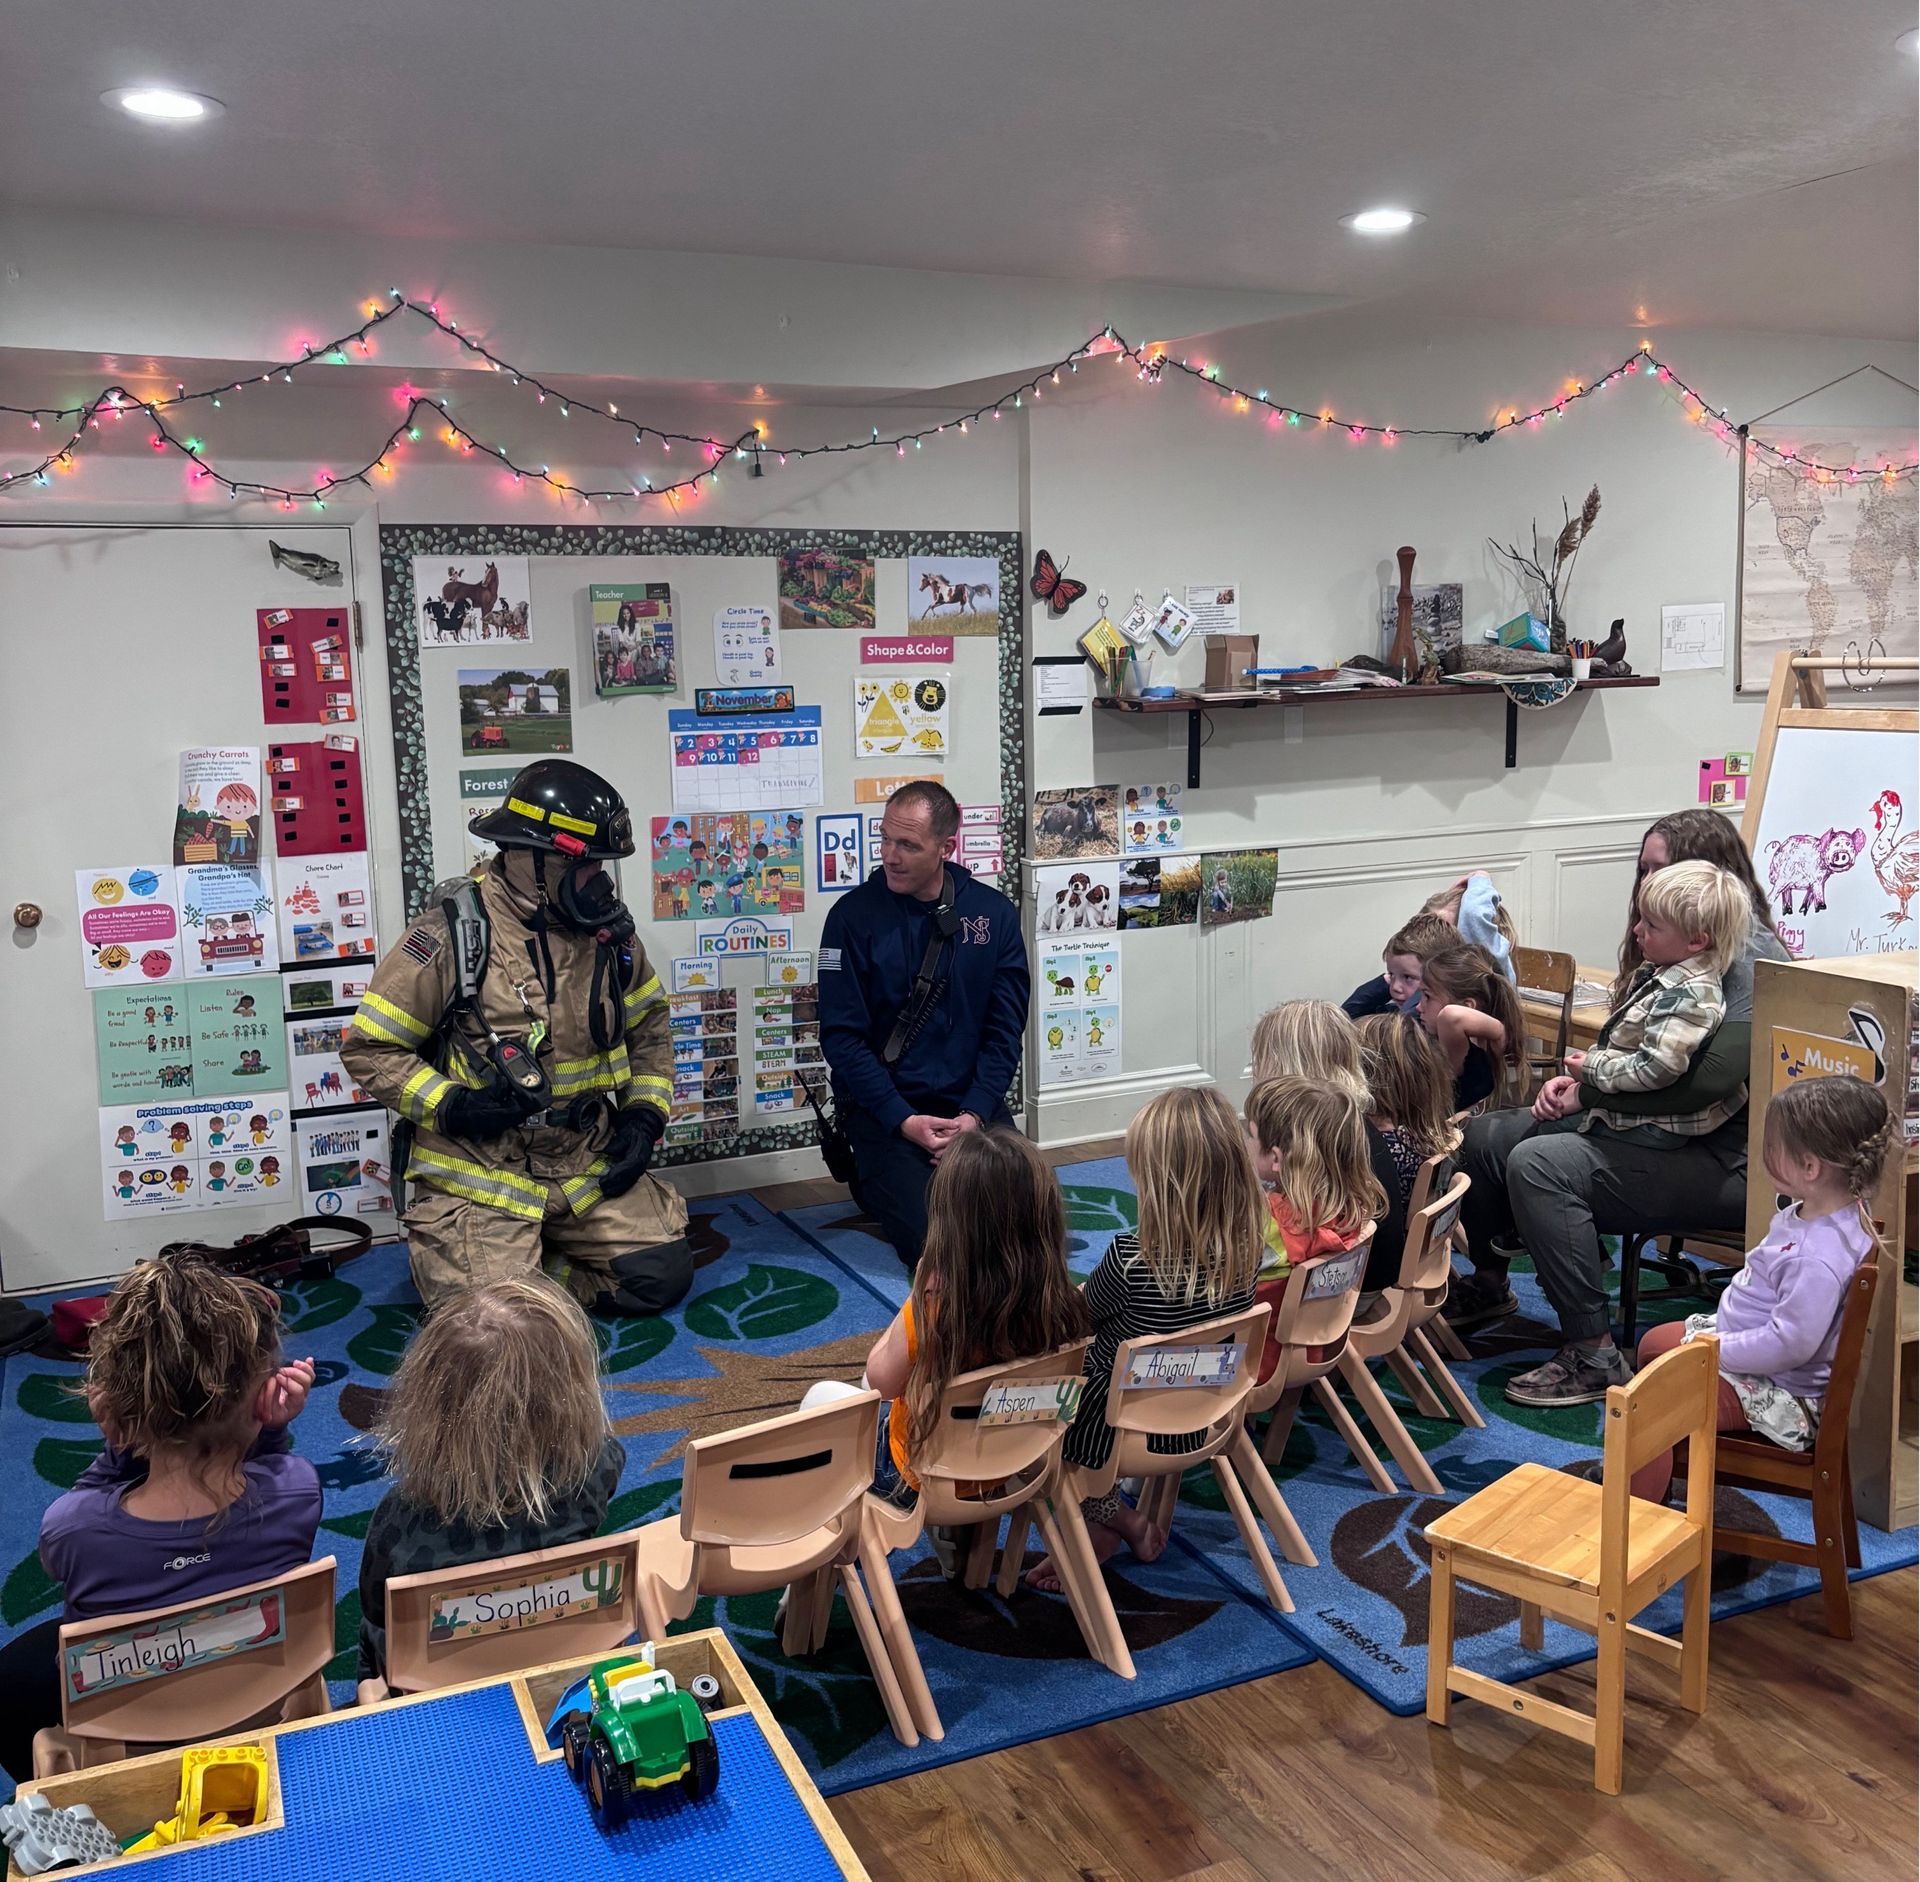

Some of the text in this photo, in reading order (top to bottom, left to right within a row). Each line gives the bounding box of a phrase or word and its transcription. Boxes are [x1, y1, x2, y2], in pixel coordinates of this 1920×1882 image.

[595, 590, 624, 599] Teacher
[716, 693, 773, 705] November
[909, 713, 942, 726] yellow
[687, 734, 816, 748] 2 3 4 5 6 7 8
[188, 749, 249, 760] Crunchy Carrots
[689, 752, 758, 763] 9 10 11 12
[464, 778, 509, 792] Forest
[824, 828, 856, 851] Dd
[188, 865, 228, 874] Grandma's
[326, 863, 343, 871] Chart
[967, 862, 979, 871] up
[198, 871, 251, 881] Grandpa's Hat
[732, 925, 758, 935] Daily
[703, 934, 787, 952] ROUTINES
[1846, 928, 1869, 952] Mr.
[1082, 942, 1110, 950] Technique
[680, 961, 713, 970] Morning
[770, 956, 810, 965] Afternoon
[226, 988, 244, 996] Rules
[127, 995, 172, 1005] Expectations
[669, 994, 699, 1003] reakfast
[200, 1004, 223, 1012] Listen
[122, 1009, 136, 1018] good
[669, 1018, 696, 1026] Centers
[201, 1030, 229, 1040] Be Safe
[761, 1028, 787, 1036] Centers
[763, 1051, 787, 1059] STEAM
[202, 1059, 224, 1067] Share
[762, 1059, 786, 1068] STEAM
[1804, 1047, 1860, 1077] Music
[761, 1073, 787, 1081] Outside
[765, 1092, 785, 1100] Snack
[137, 1100, 253, 1118] Problem solving steps
[670, 1125, 699, 1133] Outside
[1146, 1348, 1200, 1385] Abigail
[995, 1387, 1035, 1422] Aspen
[163, 1552, 211, 1571] FORCE
[475, 1586, 572, 1628] Sophia
[1316, 1607, 1410, 1675] Lakeshore
[94, 1631, 198, 1672] Tinleigh
